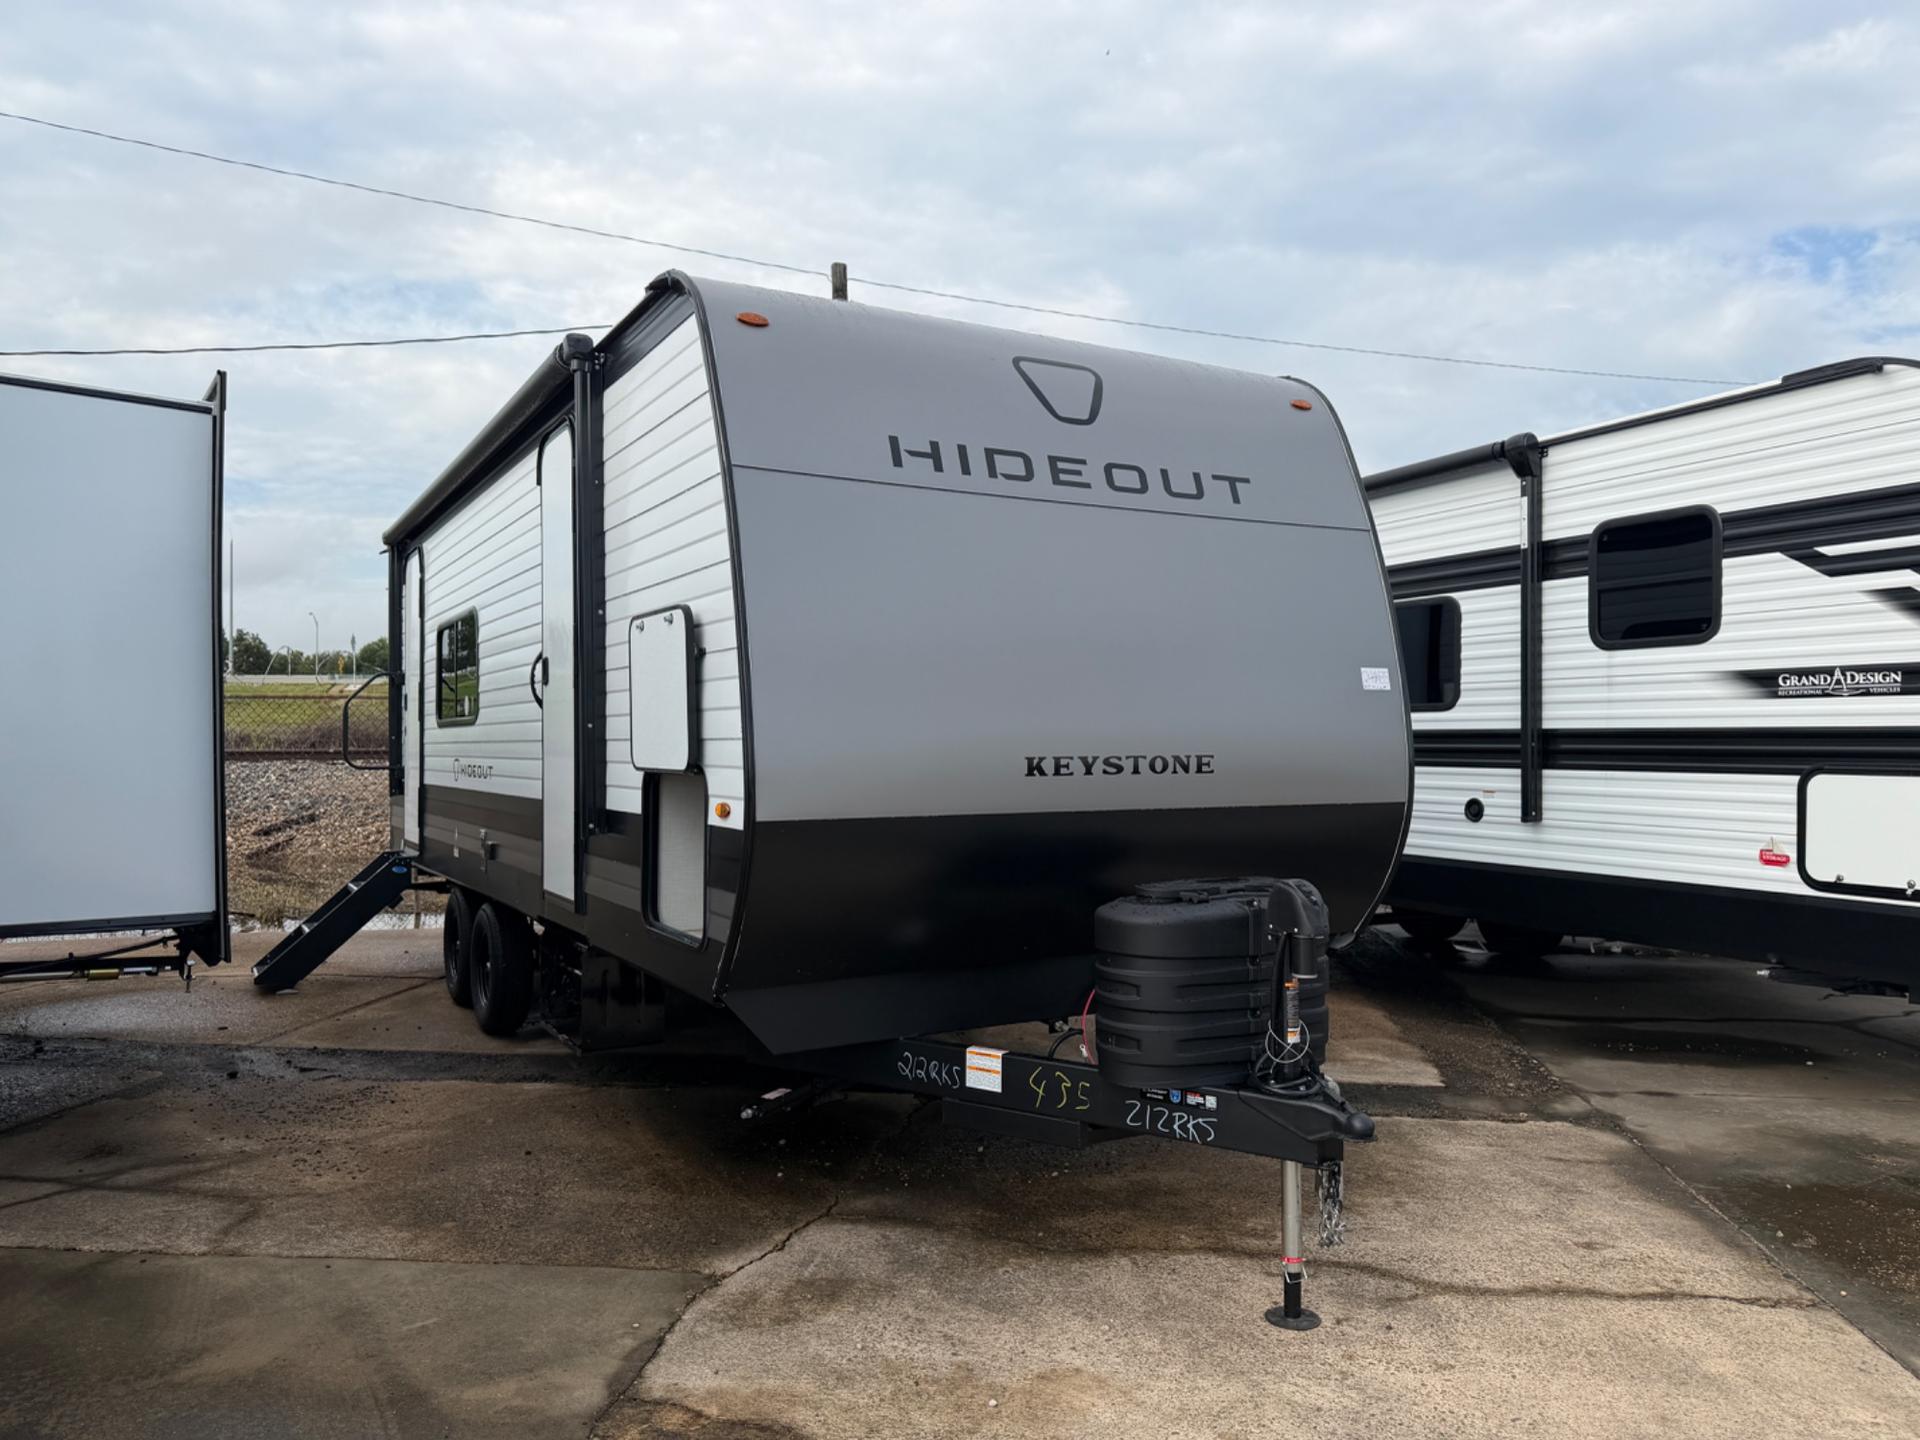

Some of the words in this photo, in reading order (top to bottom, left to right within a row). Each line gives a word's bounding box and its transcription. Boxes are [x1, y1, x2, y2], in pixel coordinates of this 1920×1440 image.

[888, 435, 1251, 505] HIDEOUT
[1778, 673, 1831, 687] GRAND
[1846, 670, 1902, 685] DESIGN
[460, 764, 494, 780] HIDEOUT
[1024, 755, 1215, 777] KEYSTONE
[1029, 1066, 1090, 1110] 435
[1125, 1100, 1218, 1144] 212RKS
